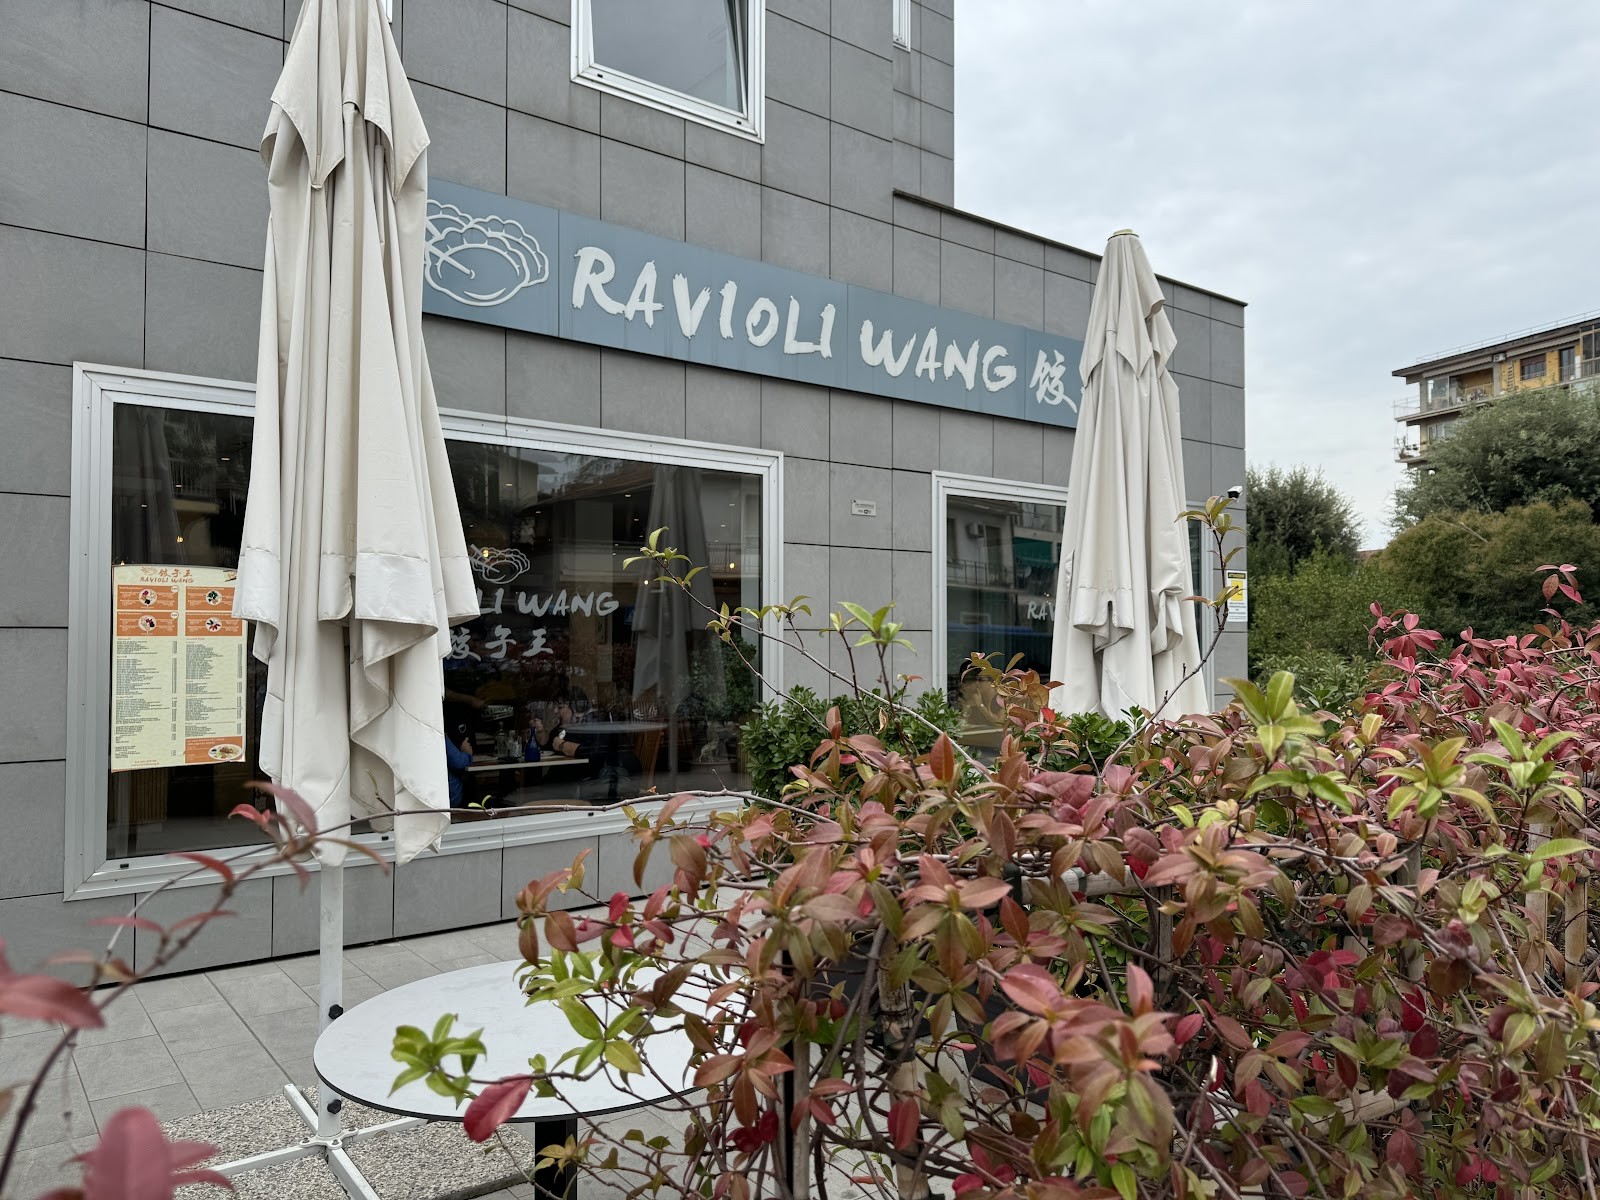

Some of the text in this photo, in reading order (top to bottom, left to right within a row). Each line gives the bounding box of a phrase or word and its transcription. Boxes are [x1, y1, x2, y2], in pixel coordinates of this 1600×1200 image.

[572, 246, 1018, 393] RAVIOLI WANG
[1029, 349, 1085, 413] 饺
[171, 576, 194, 584] WANG
[517, 588, 620, 617] WANG
